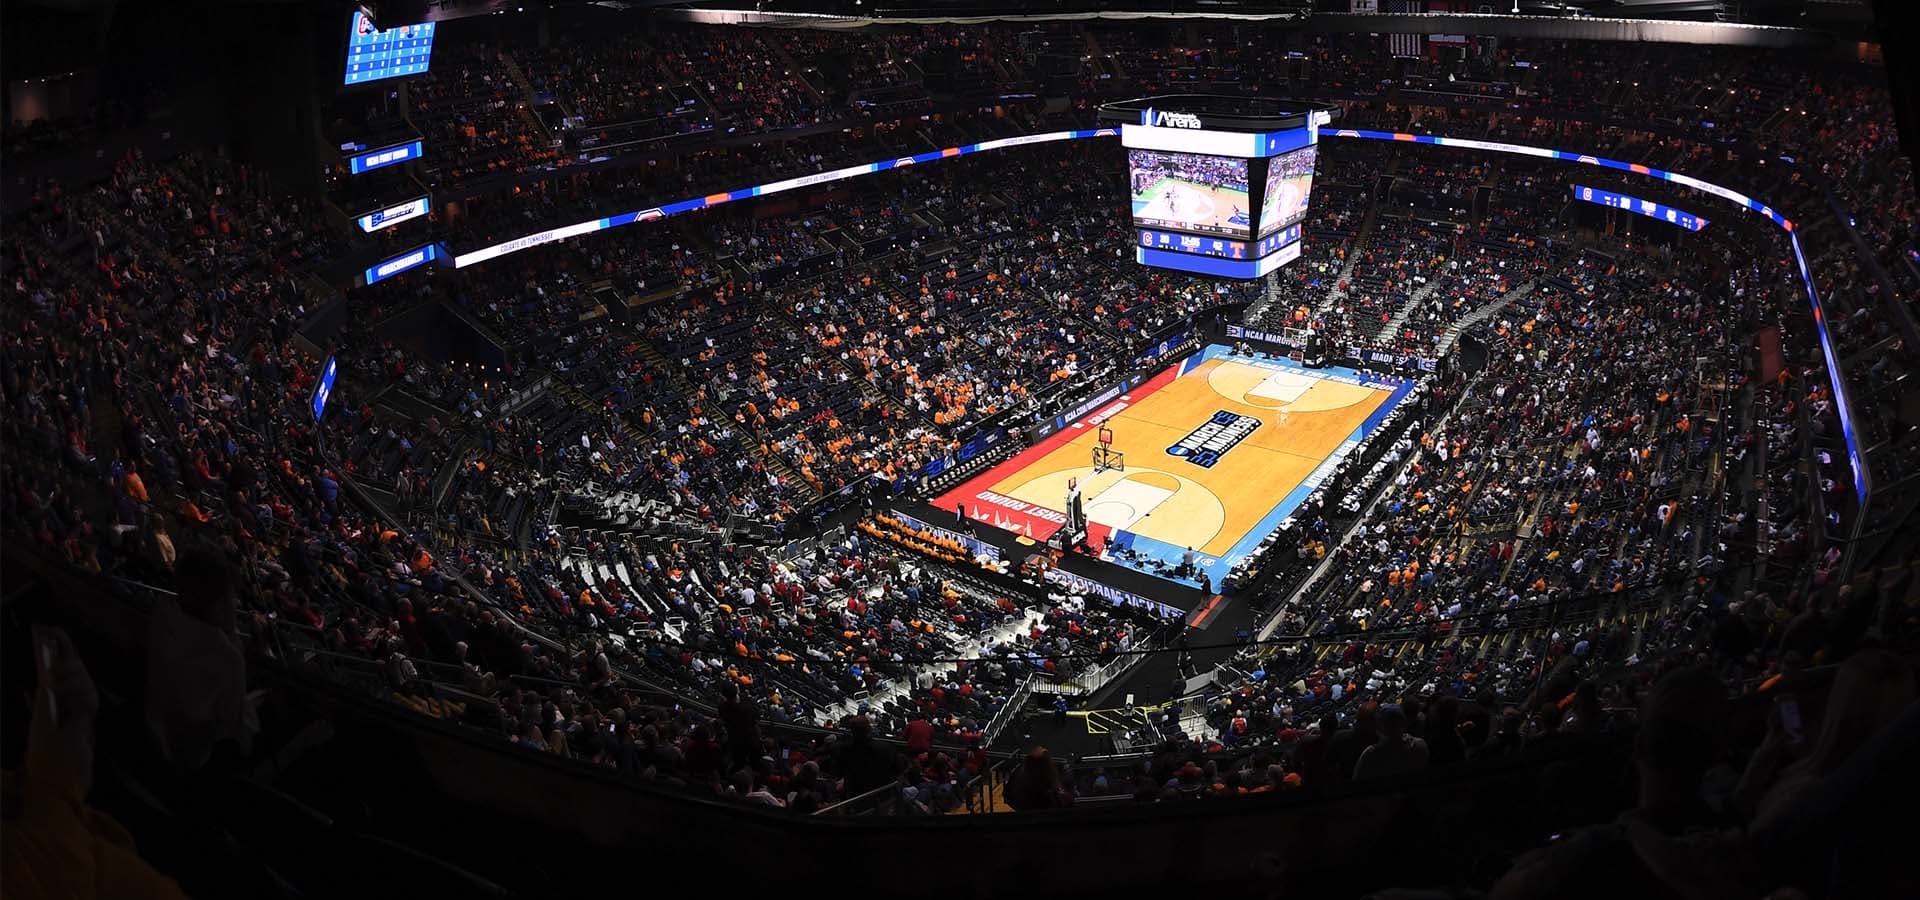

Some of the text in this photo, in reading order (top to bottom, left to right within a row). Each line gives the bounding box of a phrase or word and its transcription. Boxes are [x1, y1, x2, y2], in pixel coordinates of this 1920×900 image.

[1156, 111, 1201, 128] Arena
[1244, 330, 1290, 345] NCAA MARC
[1371, 352, 1408, 365] MADNES
[1363, 381, 1397, 391] FOUR
[1178, 421, 1226, 451] MARCH
[1201, 416, 1258, 452] MADNESS
[976, 491, 1068, 524] FIRST ROUND
